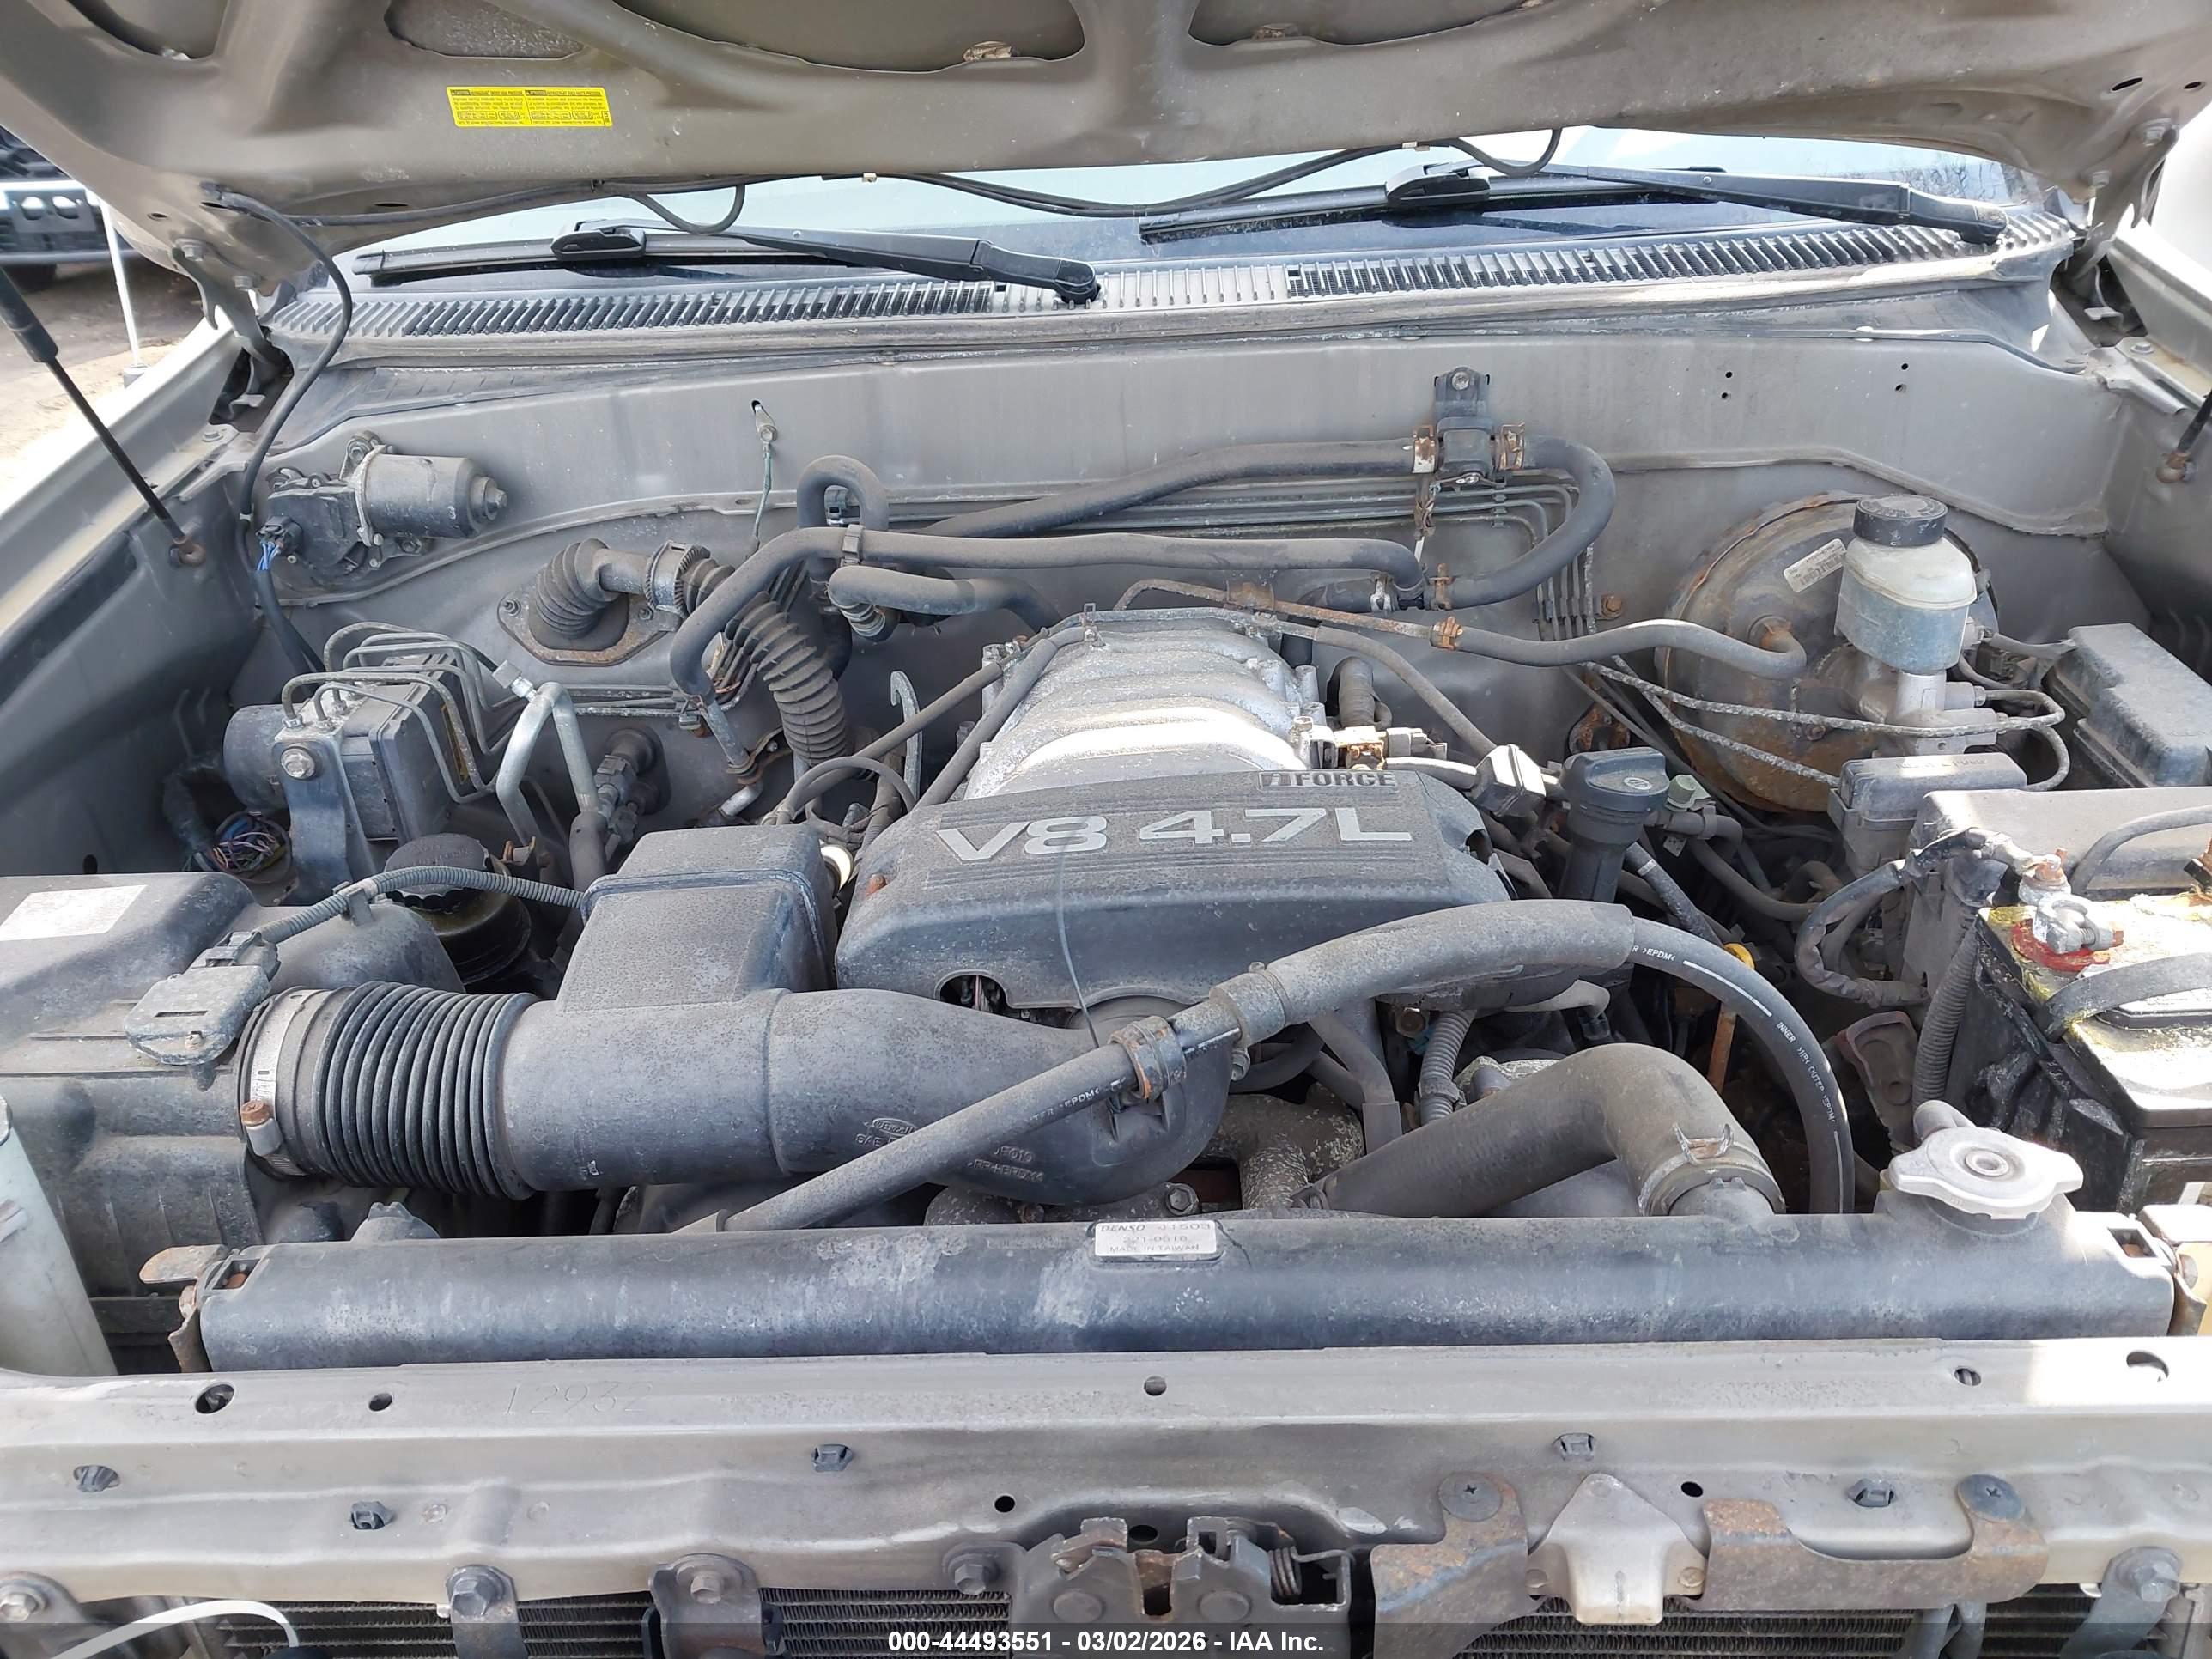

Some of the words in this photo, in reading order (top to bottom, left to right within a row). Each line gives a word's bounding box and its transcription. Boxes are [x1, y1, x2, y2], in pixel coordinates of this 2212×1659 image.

[938, 816, 1108, 861] V8
[1138, 808, 1413, 844] 4.7L
[1777, 1022, 1796, 1043] INNER
[1101, 1224, 1146, 1232] DENSO
